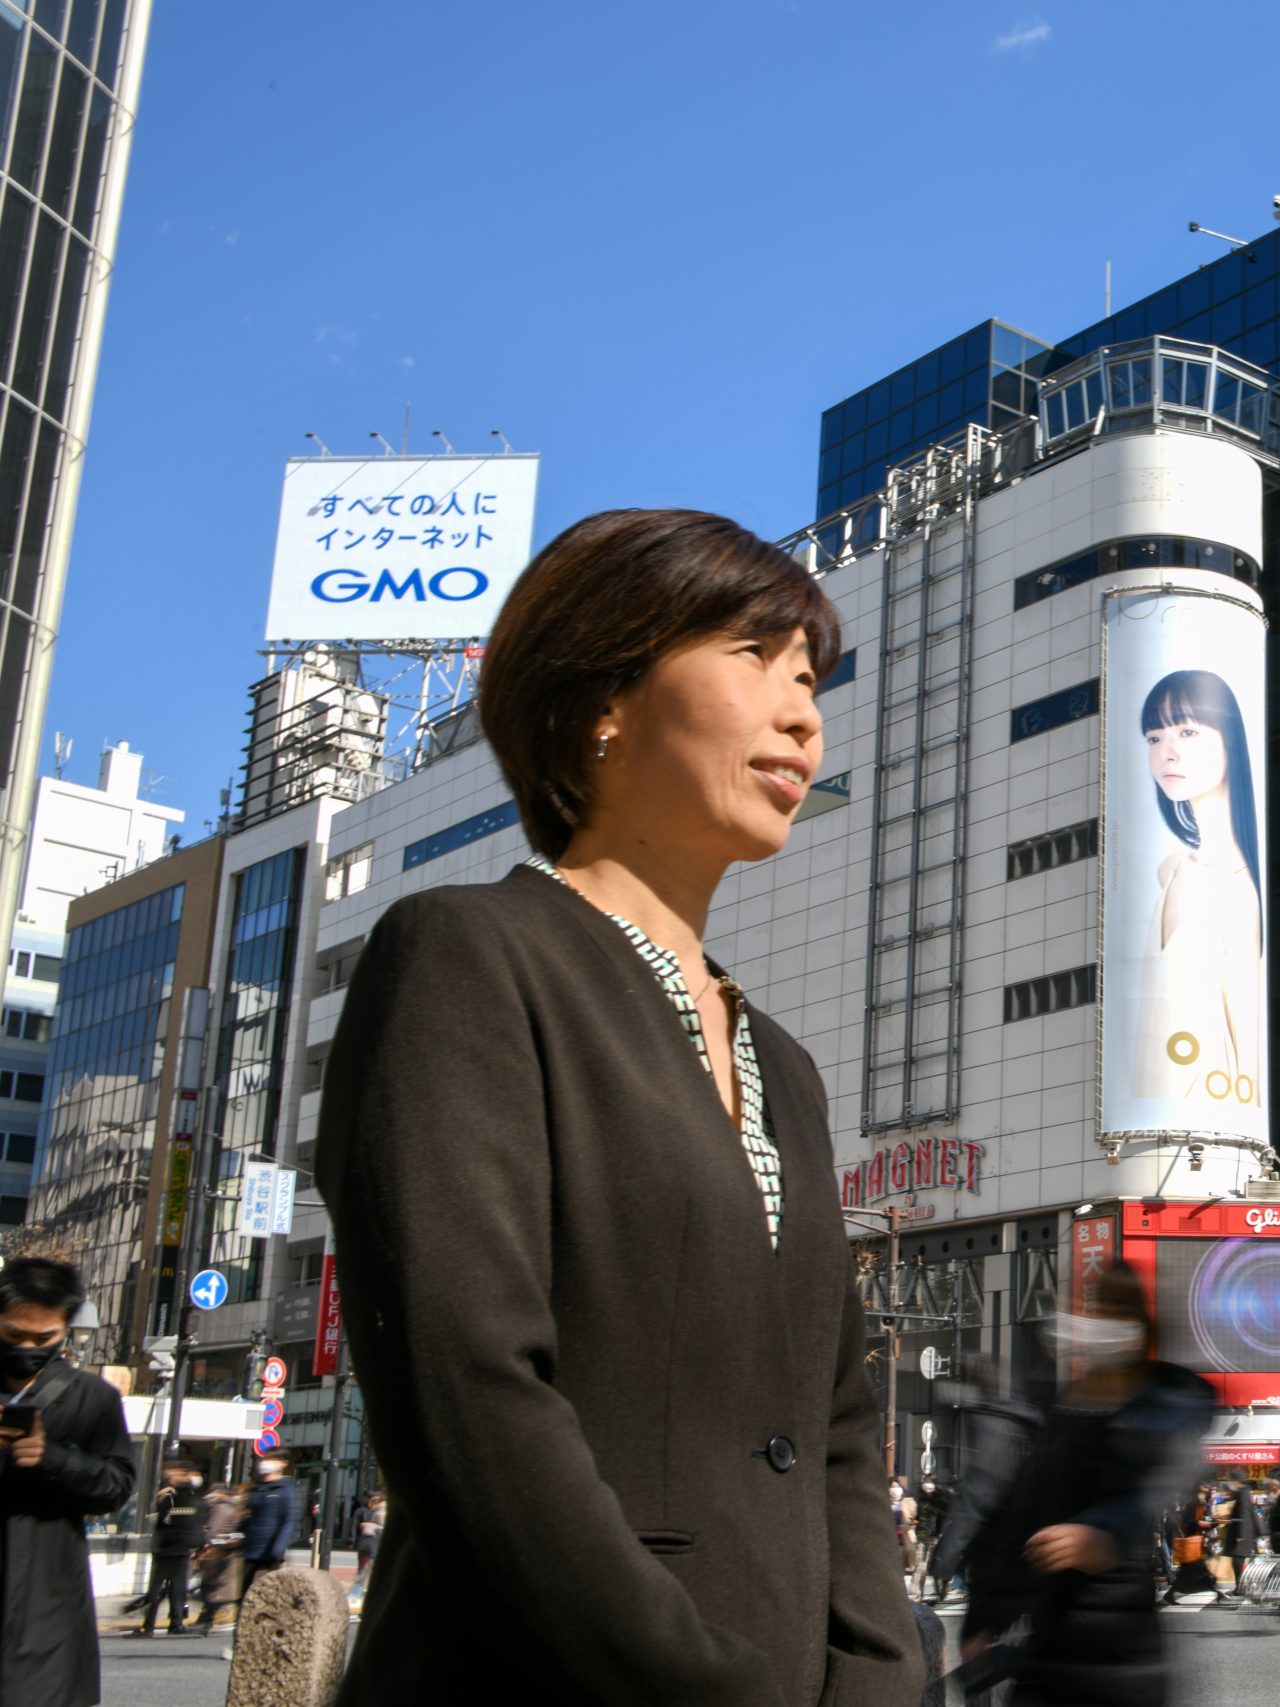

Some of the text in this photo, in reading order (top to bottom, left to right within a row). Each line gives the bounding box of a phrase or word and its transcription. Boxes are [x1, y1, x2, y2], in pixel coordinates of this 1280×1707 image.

[320, 492, 497, 519] すべての人に
[316, 525, 493, 551] インターネット
[310, 567, 489, 603] GMO
[841, 1137, 984, 1218] MAGNET
[254, 1169, 272, 1231] 渋谷駅前
[1077, 1222, 1110, 1242] 名物
